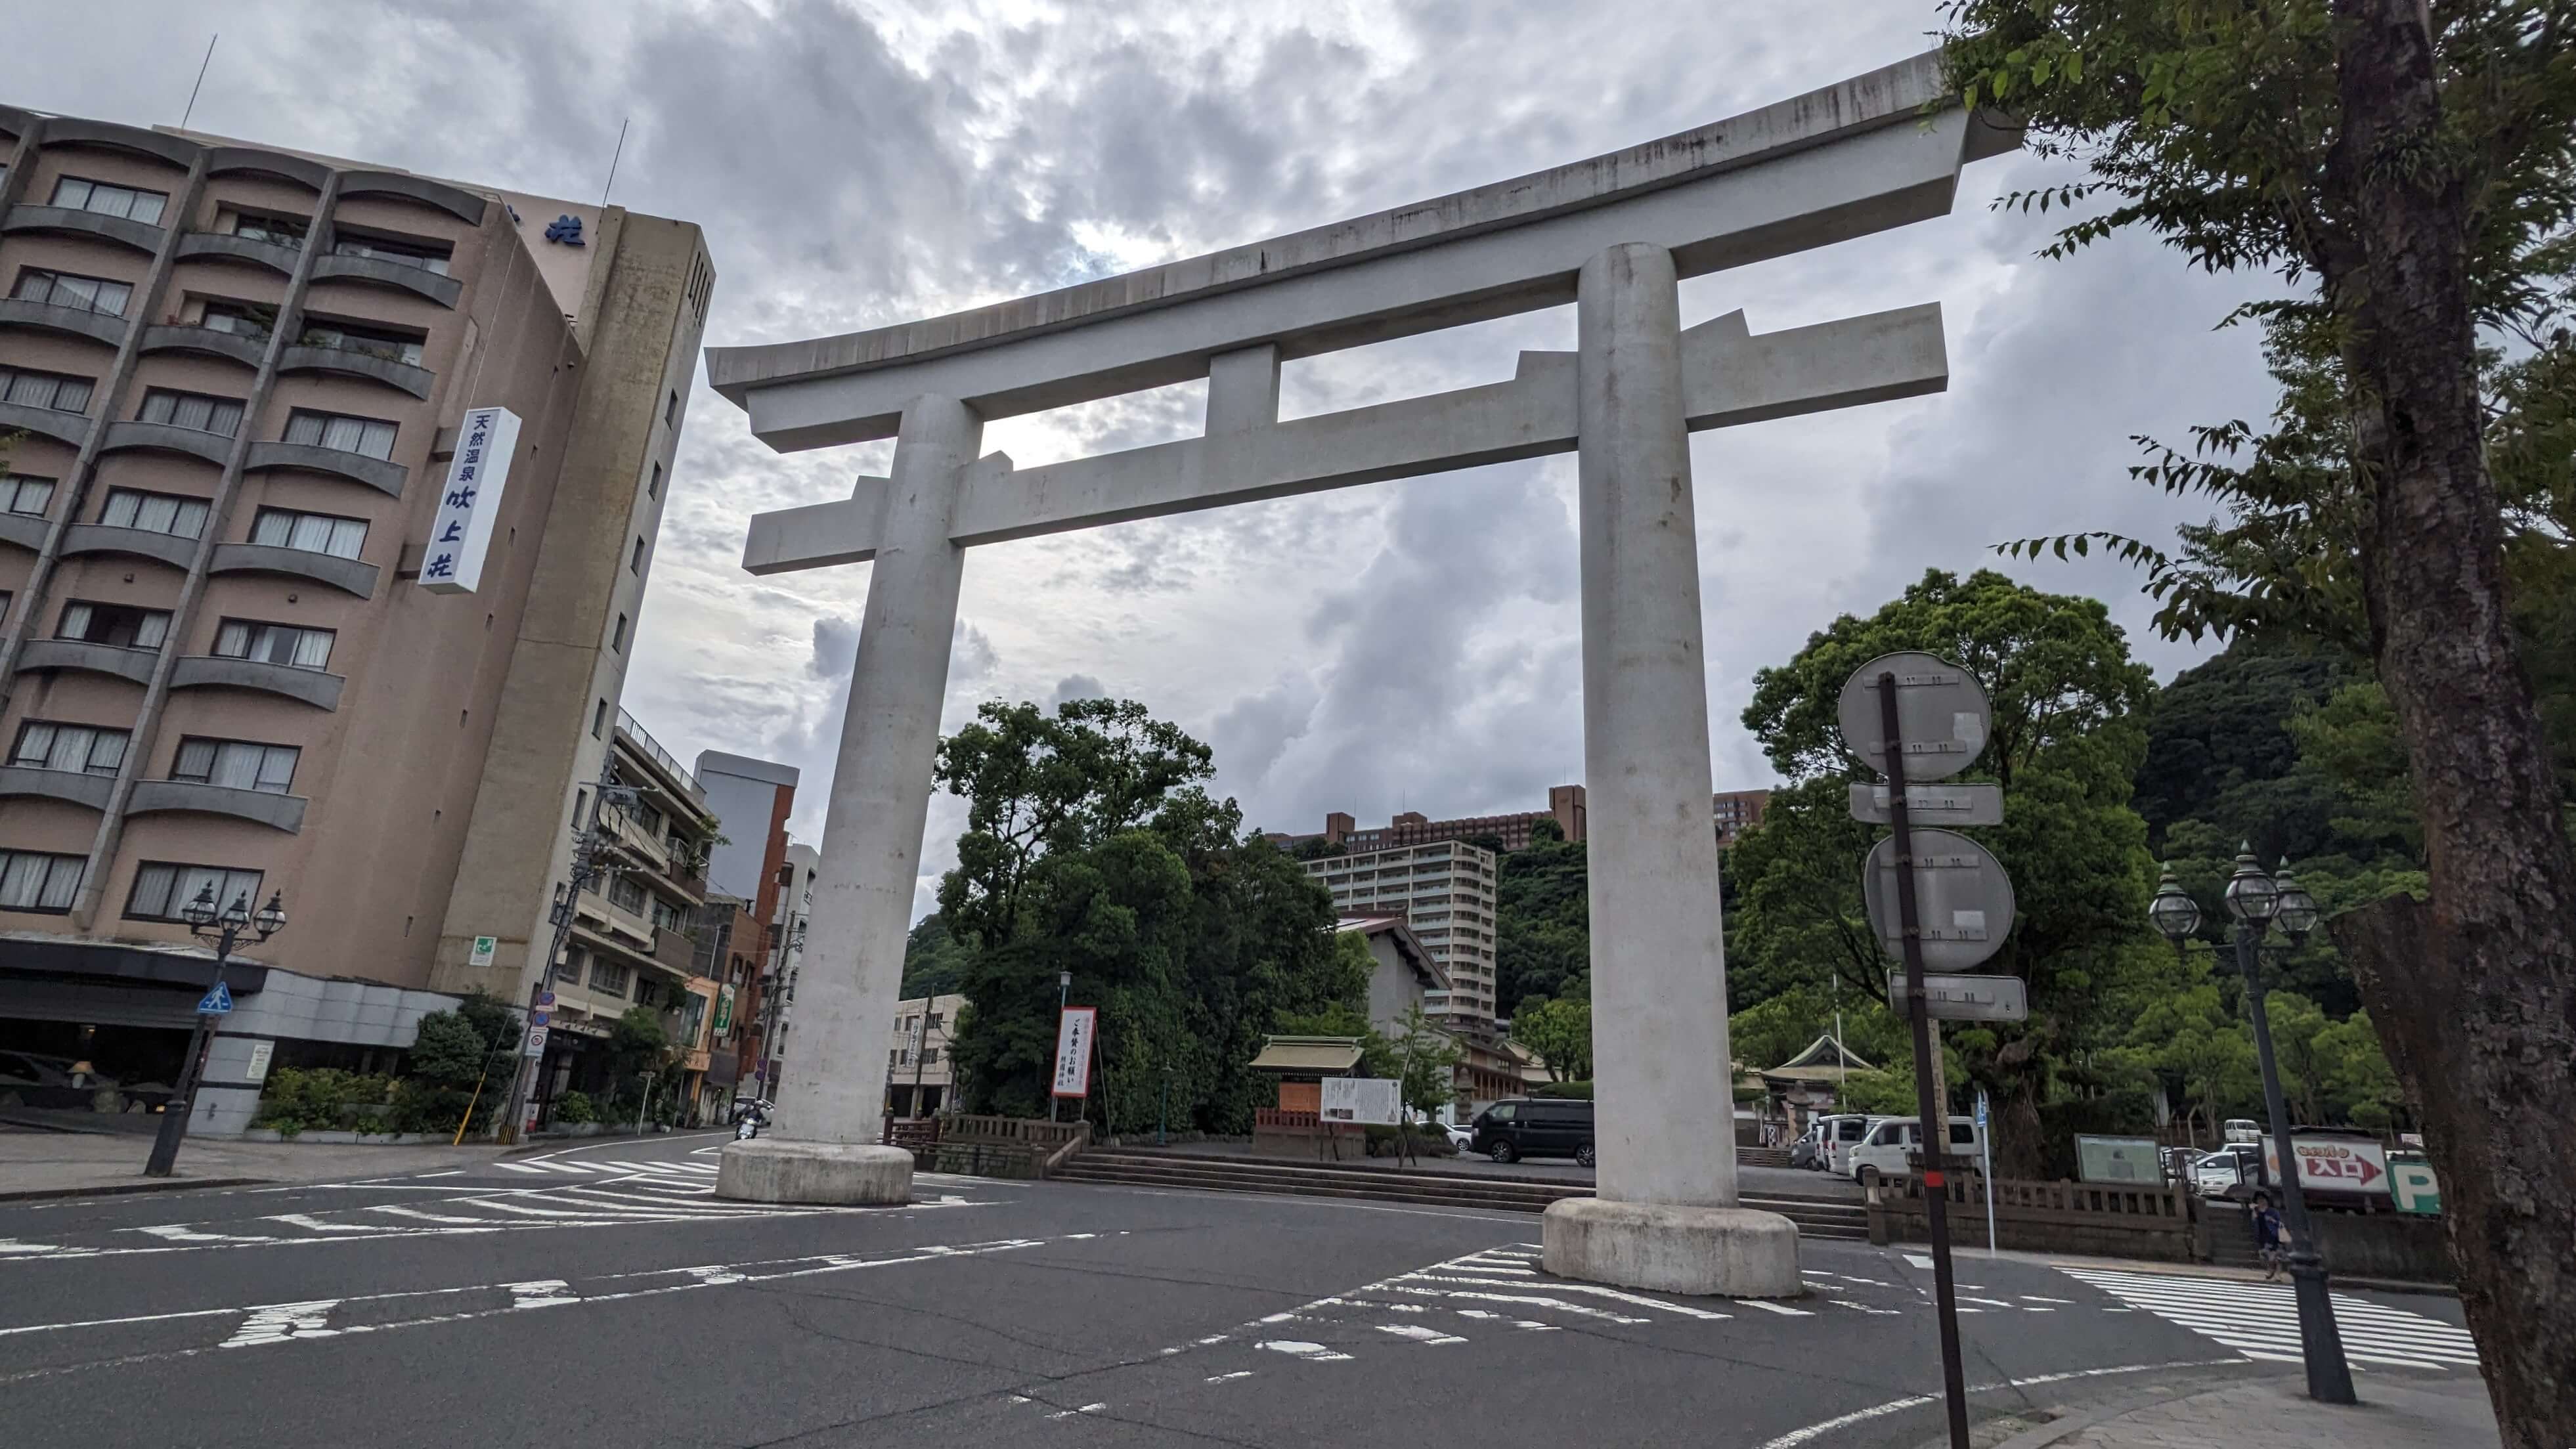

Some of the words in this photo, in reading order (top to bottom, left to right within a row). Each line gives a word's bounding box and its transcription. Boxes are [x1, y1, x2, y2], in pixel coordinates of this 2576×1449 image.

[458, 414, 491, 481] 天然温泉
[427, 486, 476, 578] 吹上荘
[2315, 1159, 2364, 1178] 入口
[2393, 1165, 2439, 1210] P
